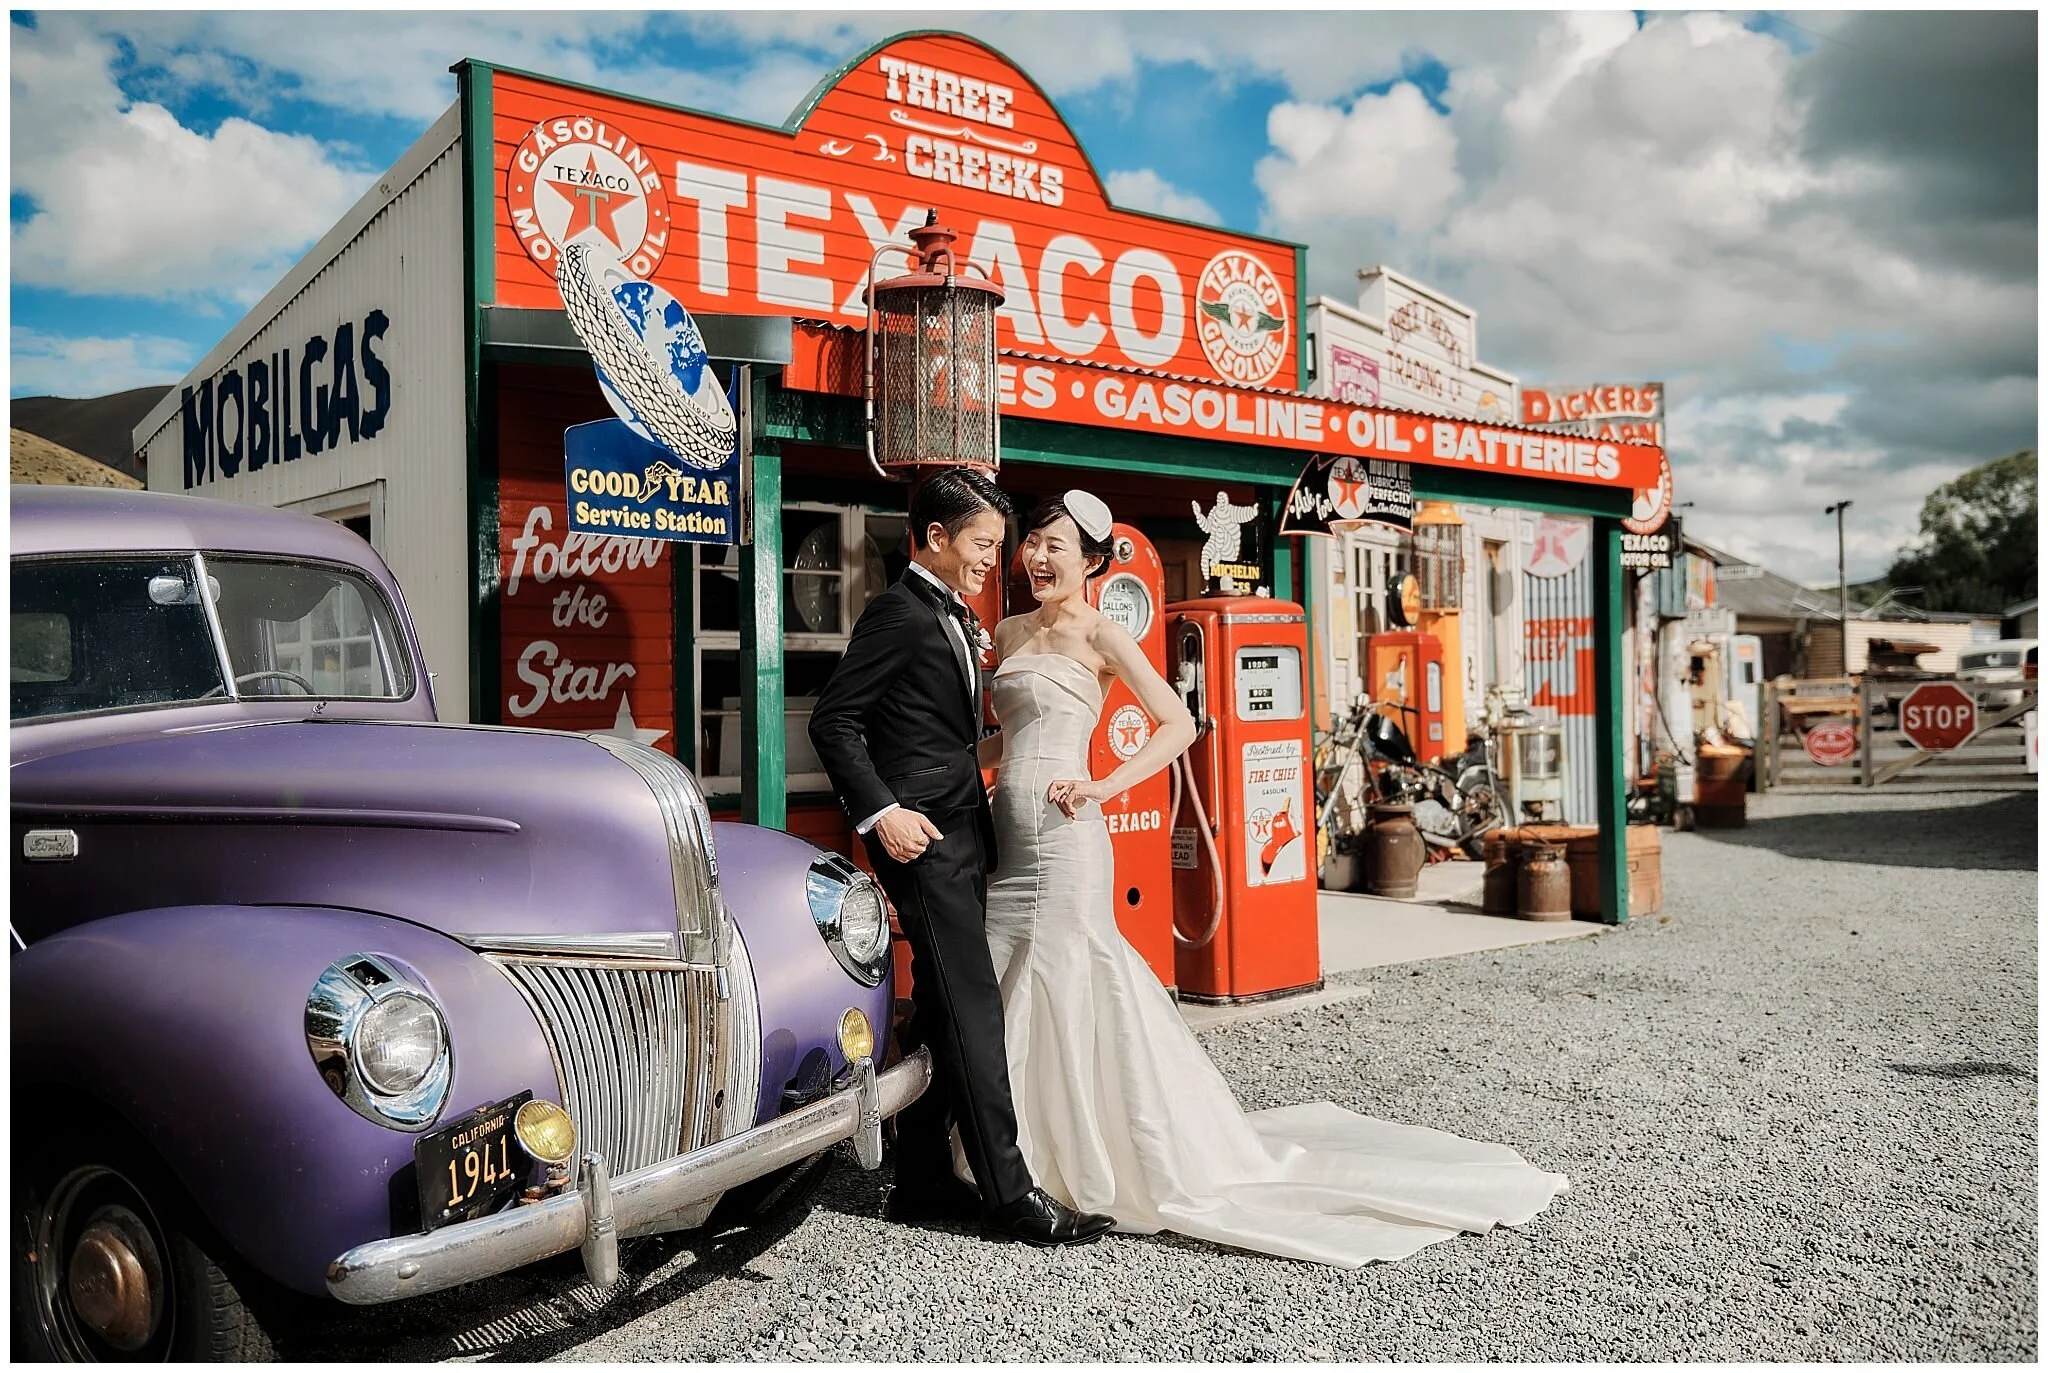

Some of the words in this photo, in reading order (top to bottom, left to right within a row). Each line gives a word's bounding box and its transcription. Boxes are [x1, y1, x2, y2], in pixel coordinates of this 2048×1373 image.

[879, 56, 1015, 130] THREE
[518, 117, 662, 195] GASOLINE
[553, 164, 630, 193] TEXACO
[905, 134, 1065, 207] CREEKS
[631, 231, 667, 277] OIL
[675, 161, 1186, 367] TEXACO
[1204, 257, 1279, 307] TEXACO
[1203, 320, 1282, 381] GASOLINE
[181, 309, 391, 490] MOBILGAS
[1521, 383, 1658, 425] DICKERS
[1093, 379, 1325, 444] GASOLINE
[1346, 410, 1412, 454] OIL
[1432, 422, 1622, 481] BATTERIES
[570, 468, 640, 499] GOOD
[665, 475, 730, 507] YEAR
[1369, 486, 1411, 505] PERFECTLY
[575, 501, 651, 531] Service
[654, 507, 728, 536] Station
[507, 506, 666, 596] follow
[1210, 563, 1260, 580] MICHELIN
[552, 584, 609, 630] the
[509, 640, 637, 718] Star
[1906, 704, 1971, 731] STOP
[1248, 769, 1271, 784] FIRE
[1273, 767, 1298, 782] CHIEF
[1262, 787, 1288, 796] GASOLINE
[452, 1114, 505, 1150] CALIFORNIA
[448, 1134, 511, 1207] 1941
